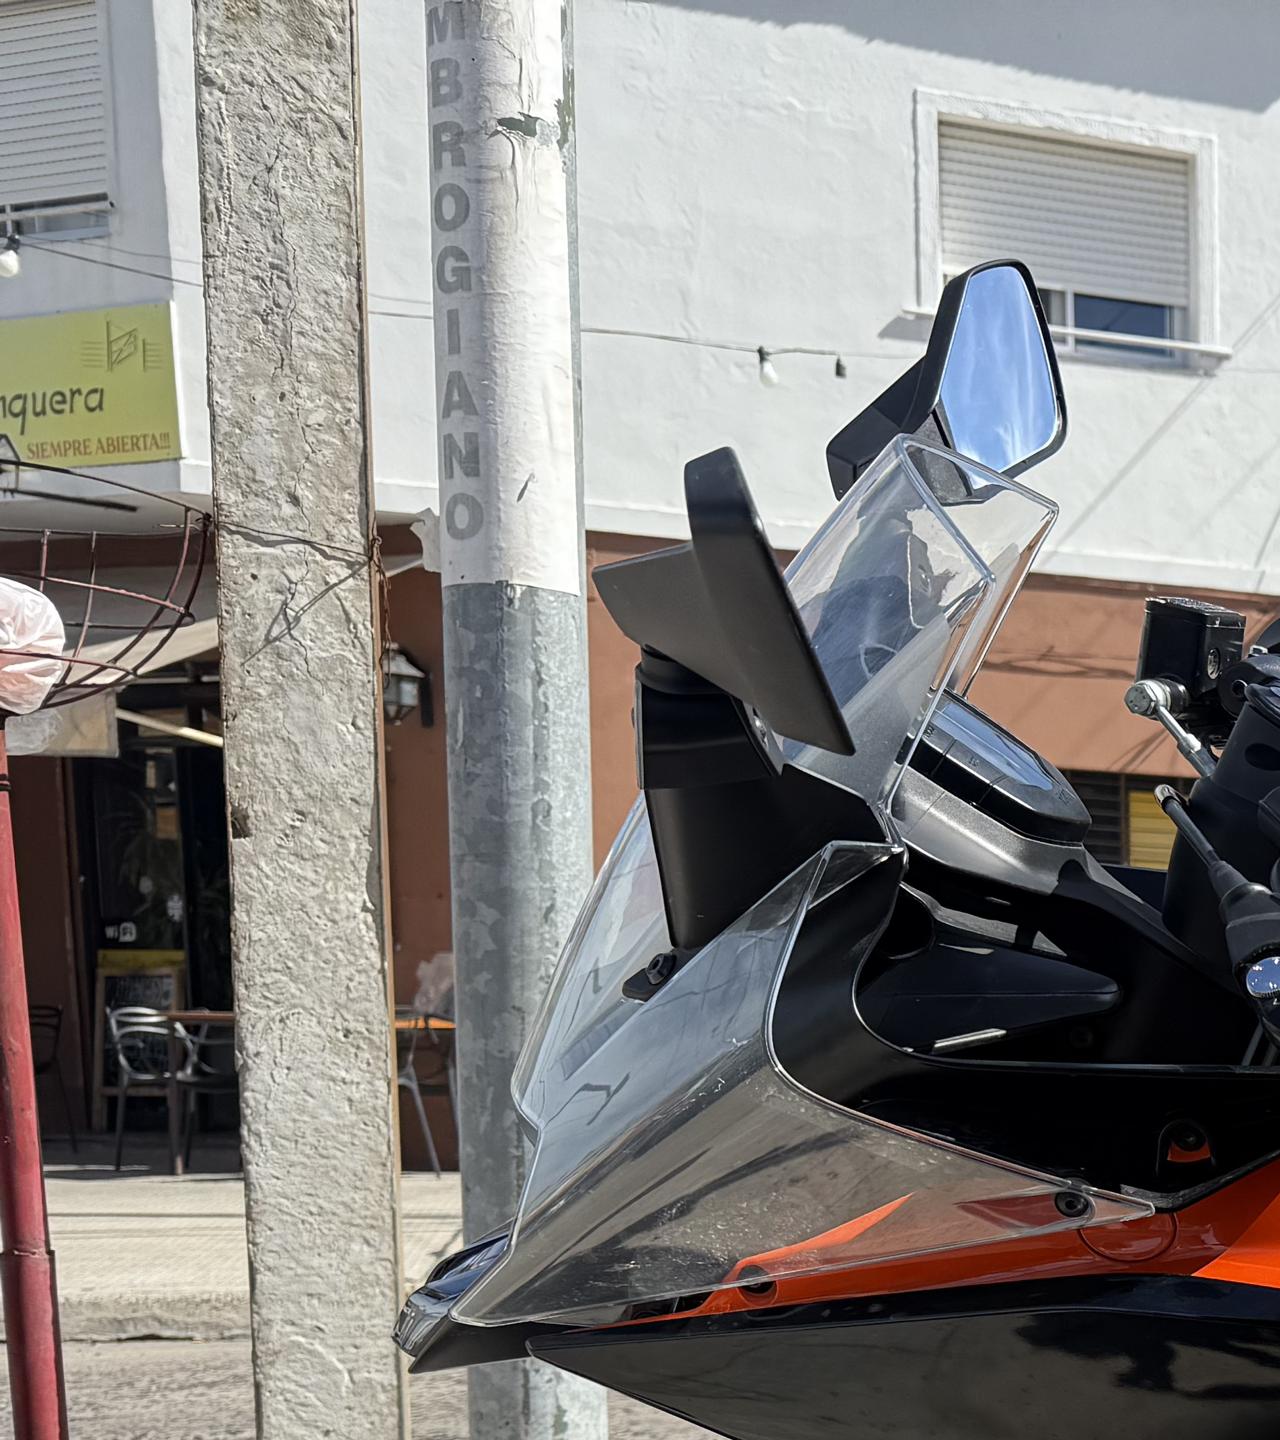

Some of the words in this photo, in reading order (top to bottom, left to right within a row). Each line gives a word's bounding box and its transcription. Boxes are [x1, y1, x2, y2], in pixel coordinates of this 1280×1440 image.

[426, 2, 485, 541] MBROGIANO
[26, 438, 92, 460] SIEMPRE
[95, 432, 171, 454] ABIERTA!!!
